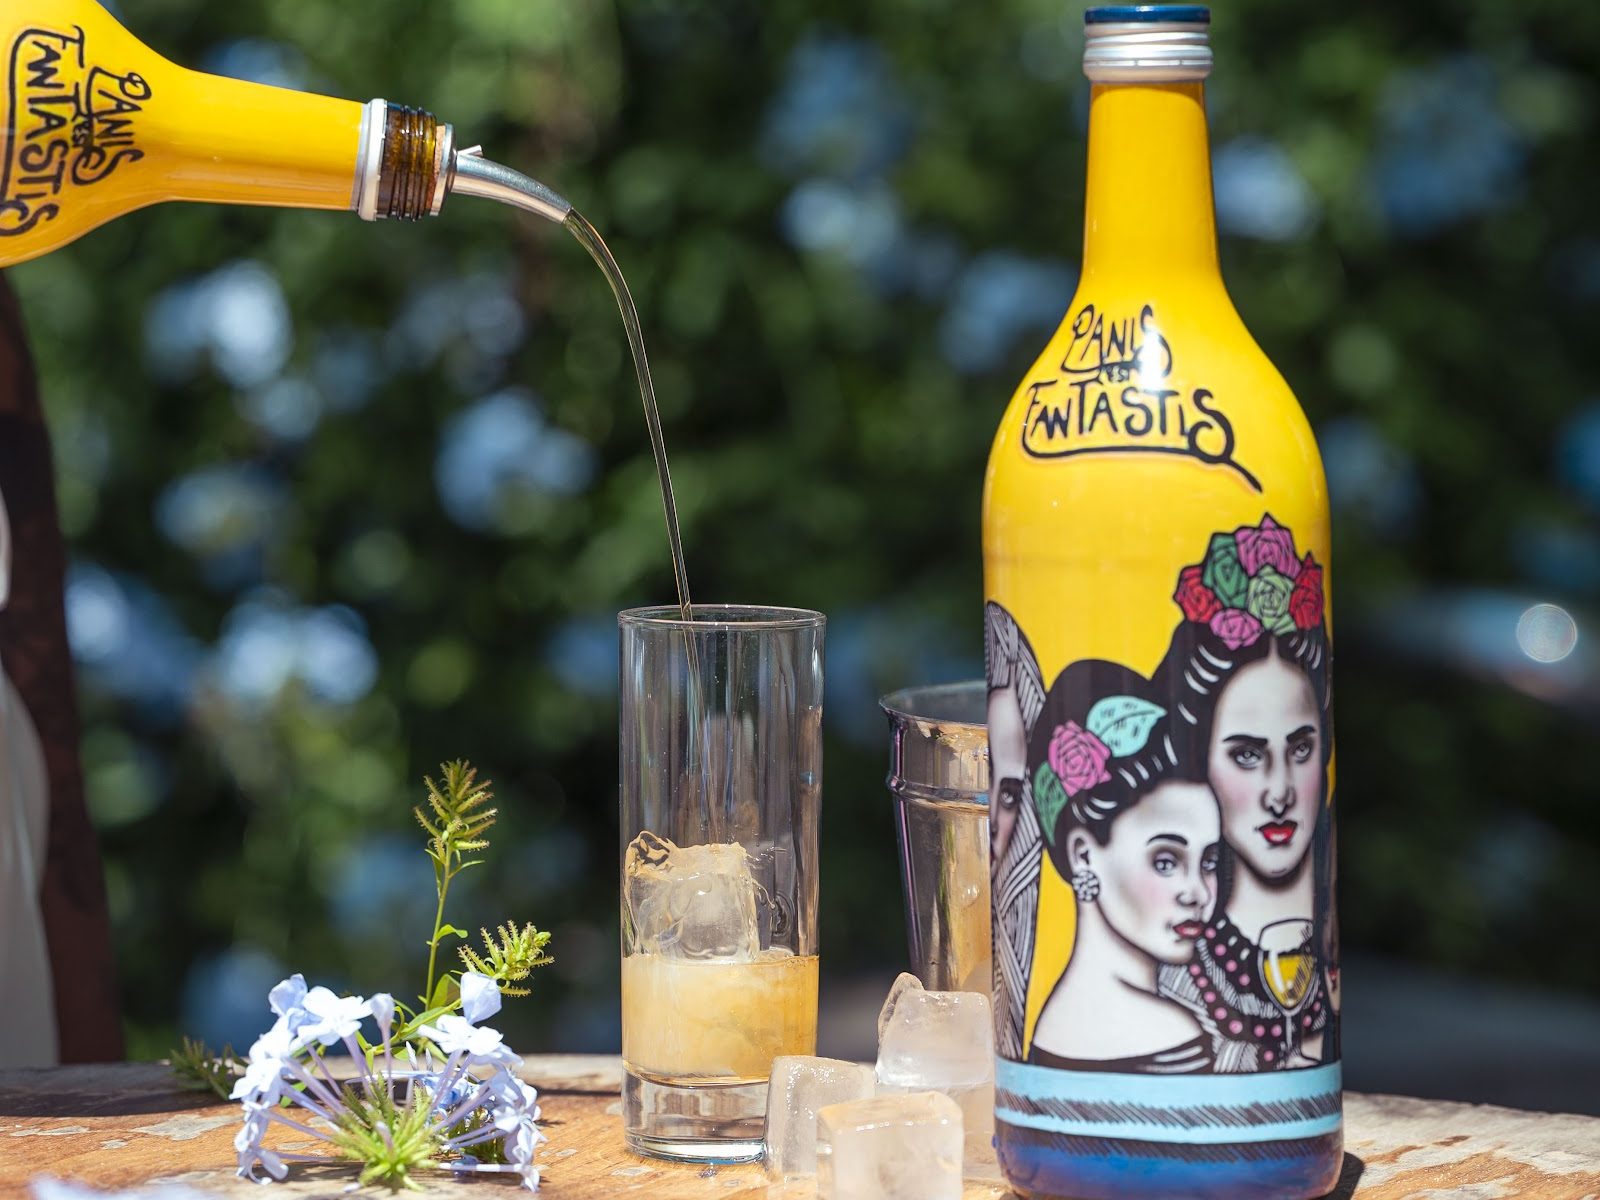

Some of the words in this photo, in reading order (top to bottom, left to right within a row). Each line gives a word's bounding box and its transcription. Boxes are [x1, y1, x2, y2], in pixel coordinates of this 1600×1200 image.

[0, 25, 84, 236] FANTASTIS
[72, 66, 152, 186] PANIS
[1061, 304, 1173, 378] PANIS
[1022, 377, 1240, 466] FANTASTIS
